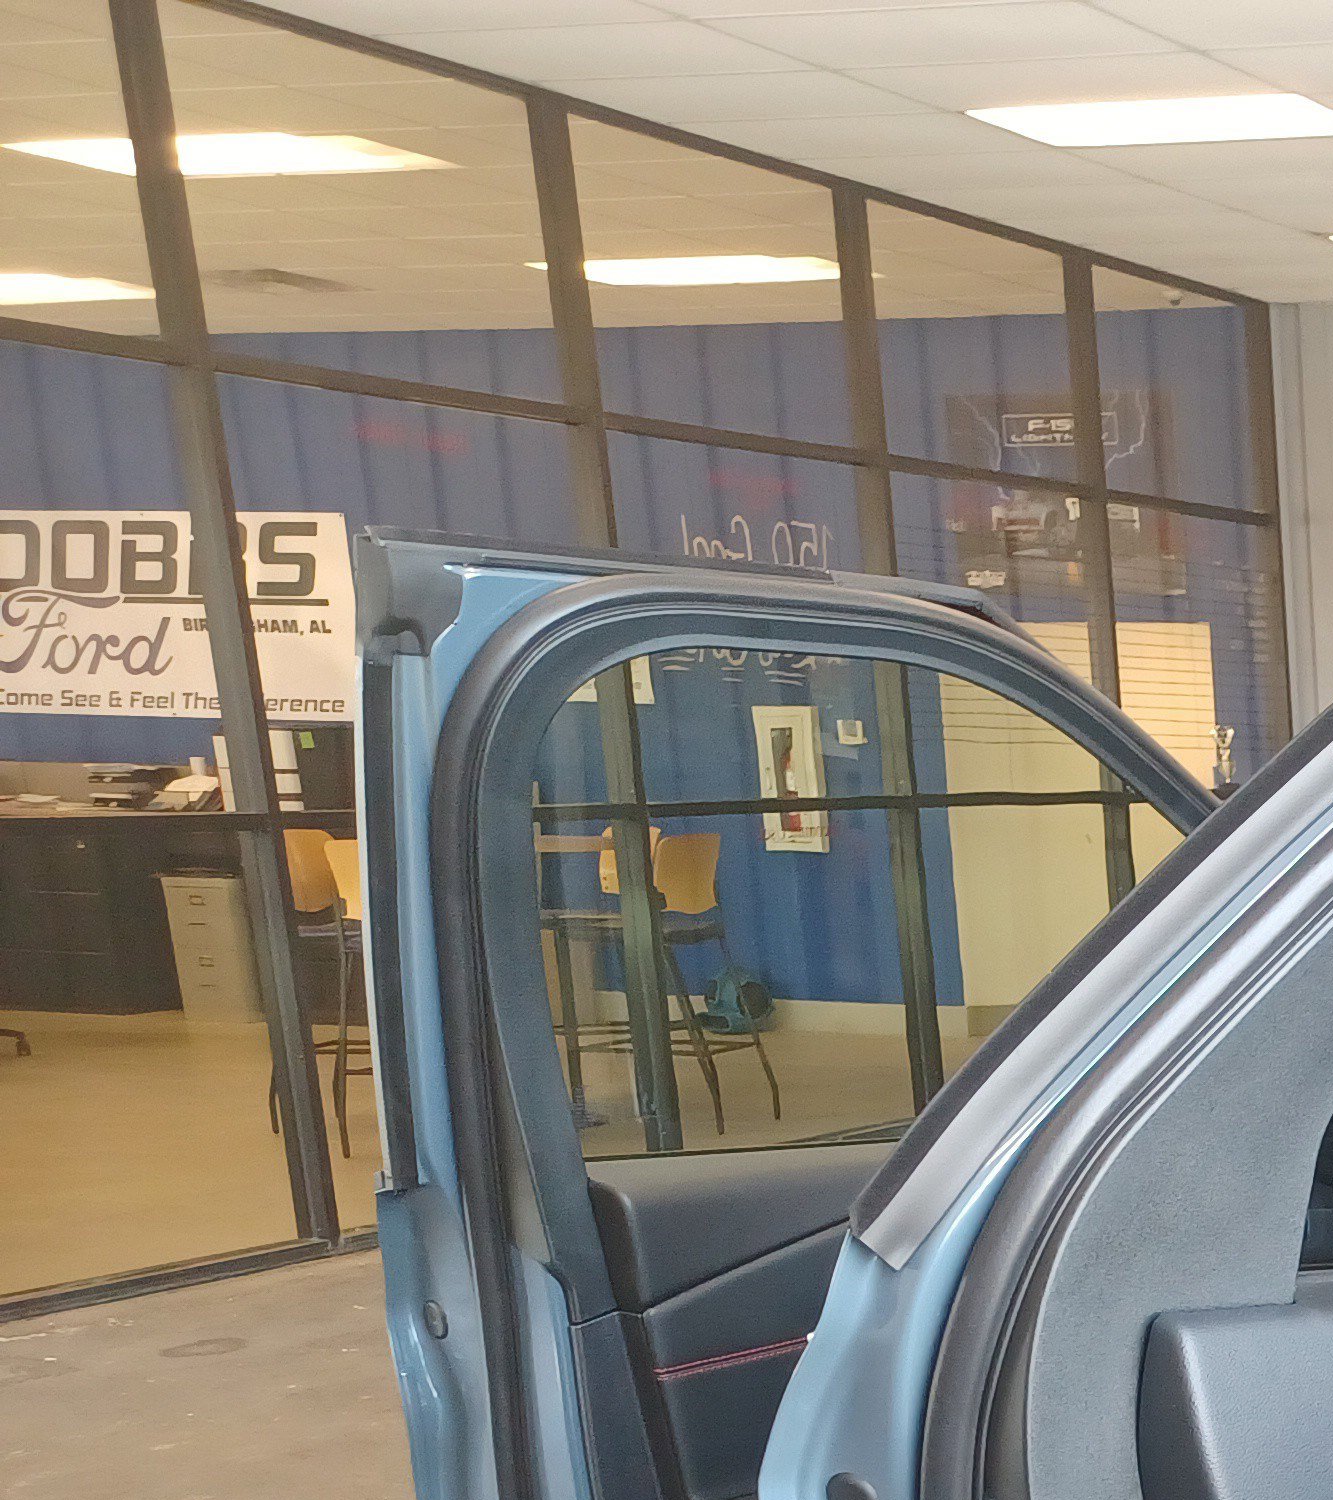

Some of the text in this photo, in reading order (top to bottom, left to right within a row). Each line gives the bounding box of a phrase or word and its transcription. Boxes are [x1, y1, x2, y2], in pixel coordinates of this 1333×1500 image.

[0, 589, 173, 676] Ford
[182, 617, 332, 636] BIRHAM, AL
[60, 689, 101, 707] See
[108, 690, 123, 708] &
[130, 691, 175, 709] Feel
[182, 692, 221, 711] The
[265, 696, 345, 713] erence
